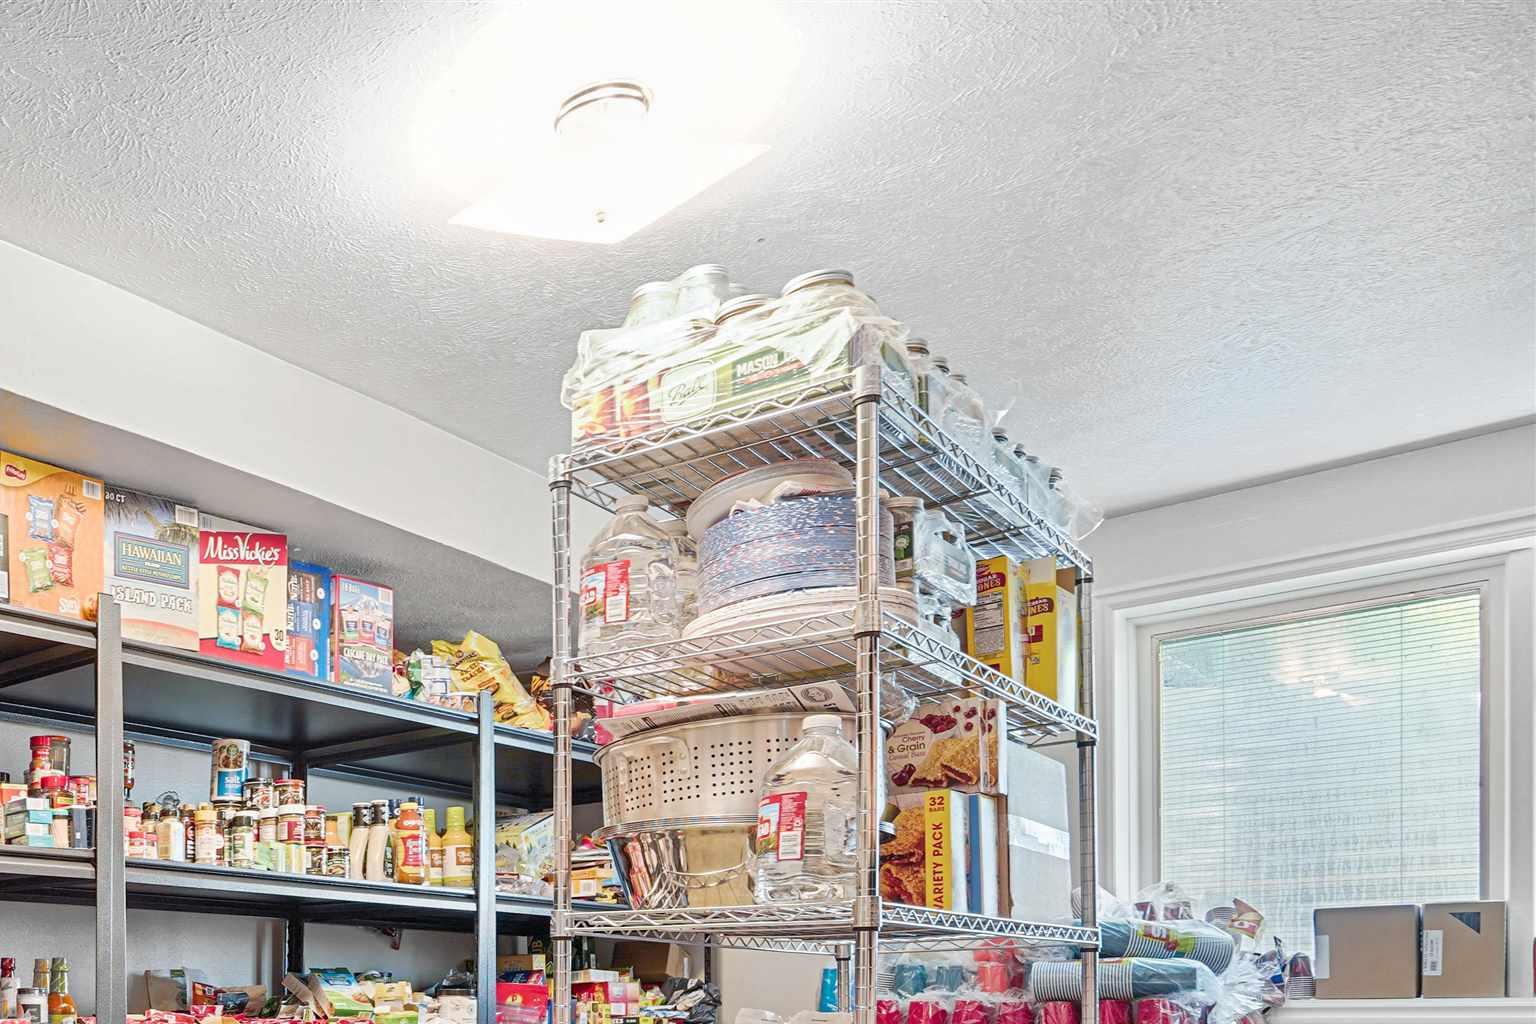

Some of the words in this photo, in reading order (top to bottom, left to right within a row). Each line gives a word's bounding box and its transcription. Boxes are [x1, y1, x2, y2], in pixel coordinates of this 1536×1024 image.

[116, 494, 126, 503] CT
[122, 543, 182, 566] HAWAIIAN
[204, 536, 239, 561] Miss
[234, 533, 281, 565] Vickie's
[111, 585, 157, 608] ISLAND
[161, 591, 193, 615] PACK
[274, 629, 284, 642] 30
[902, 735, 925, 744] Cherry
[888, 745, 895, 754] &
[897, 741, 926, 753] Grain
[929, 796, 945, 806] 32
[933, 822, 944, 860] PACK
